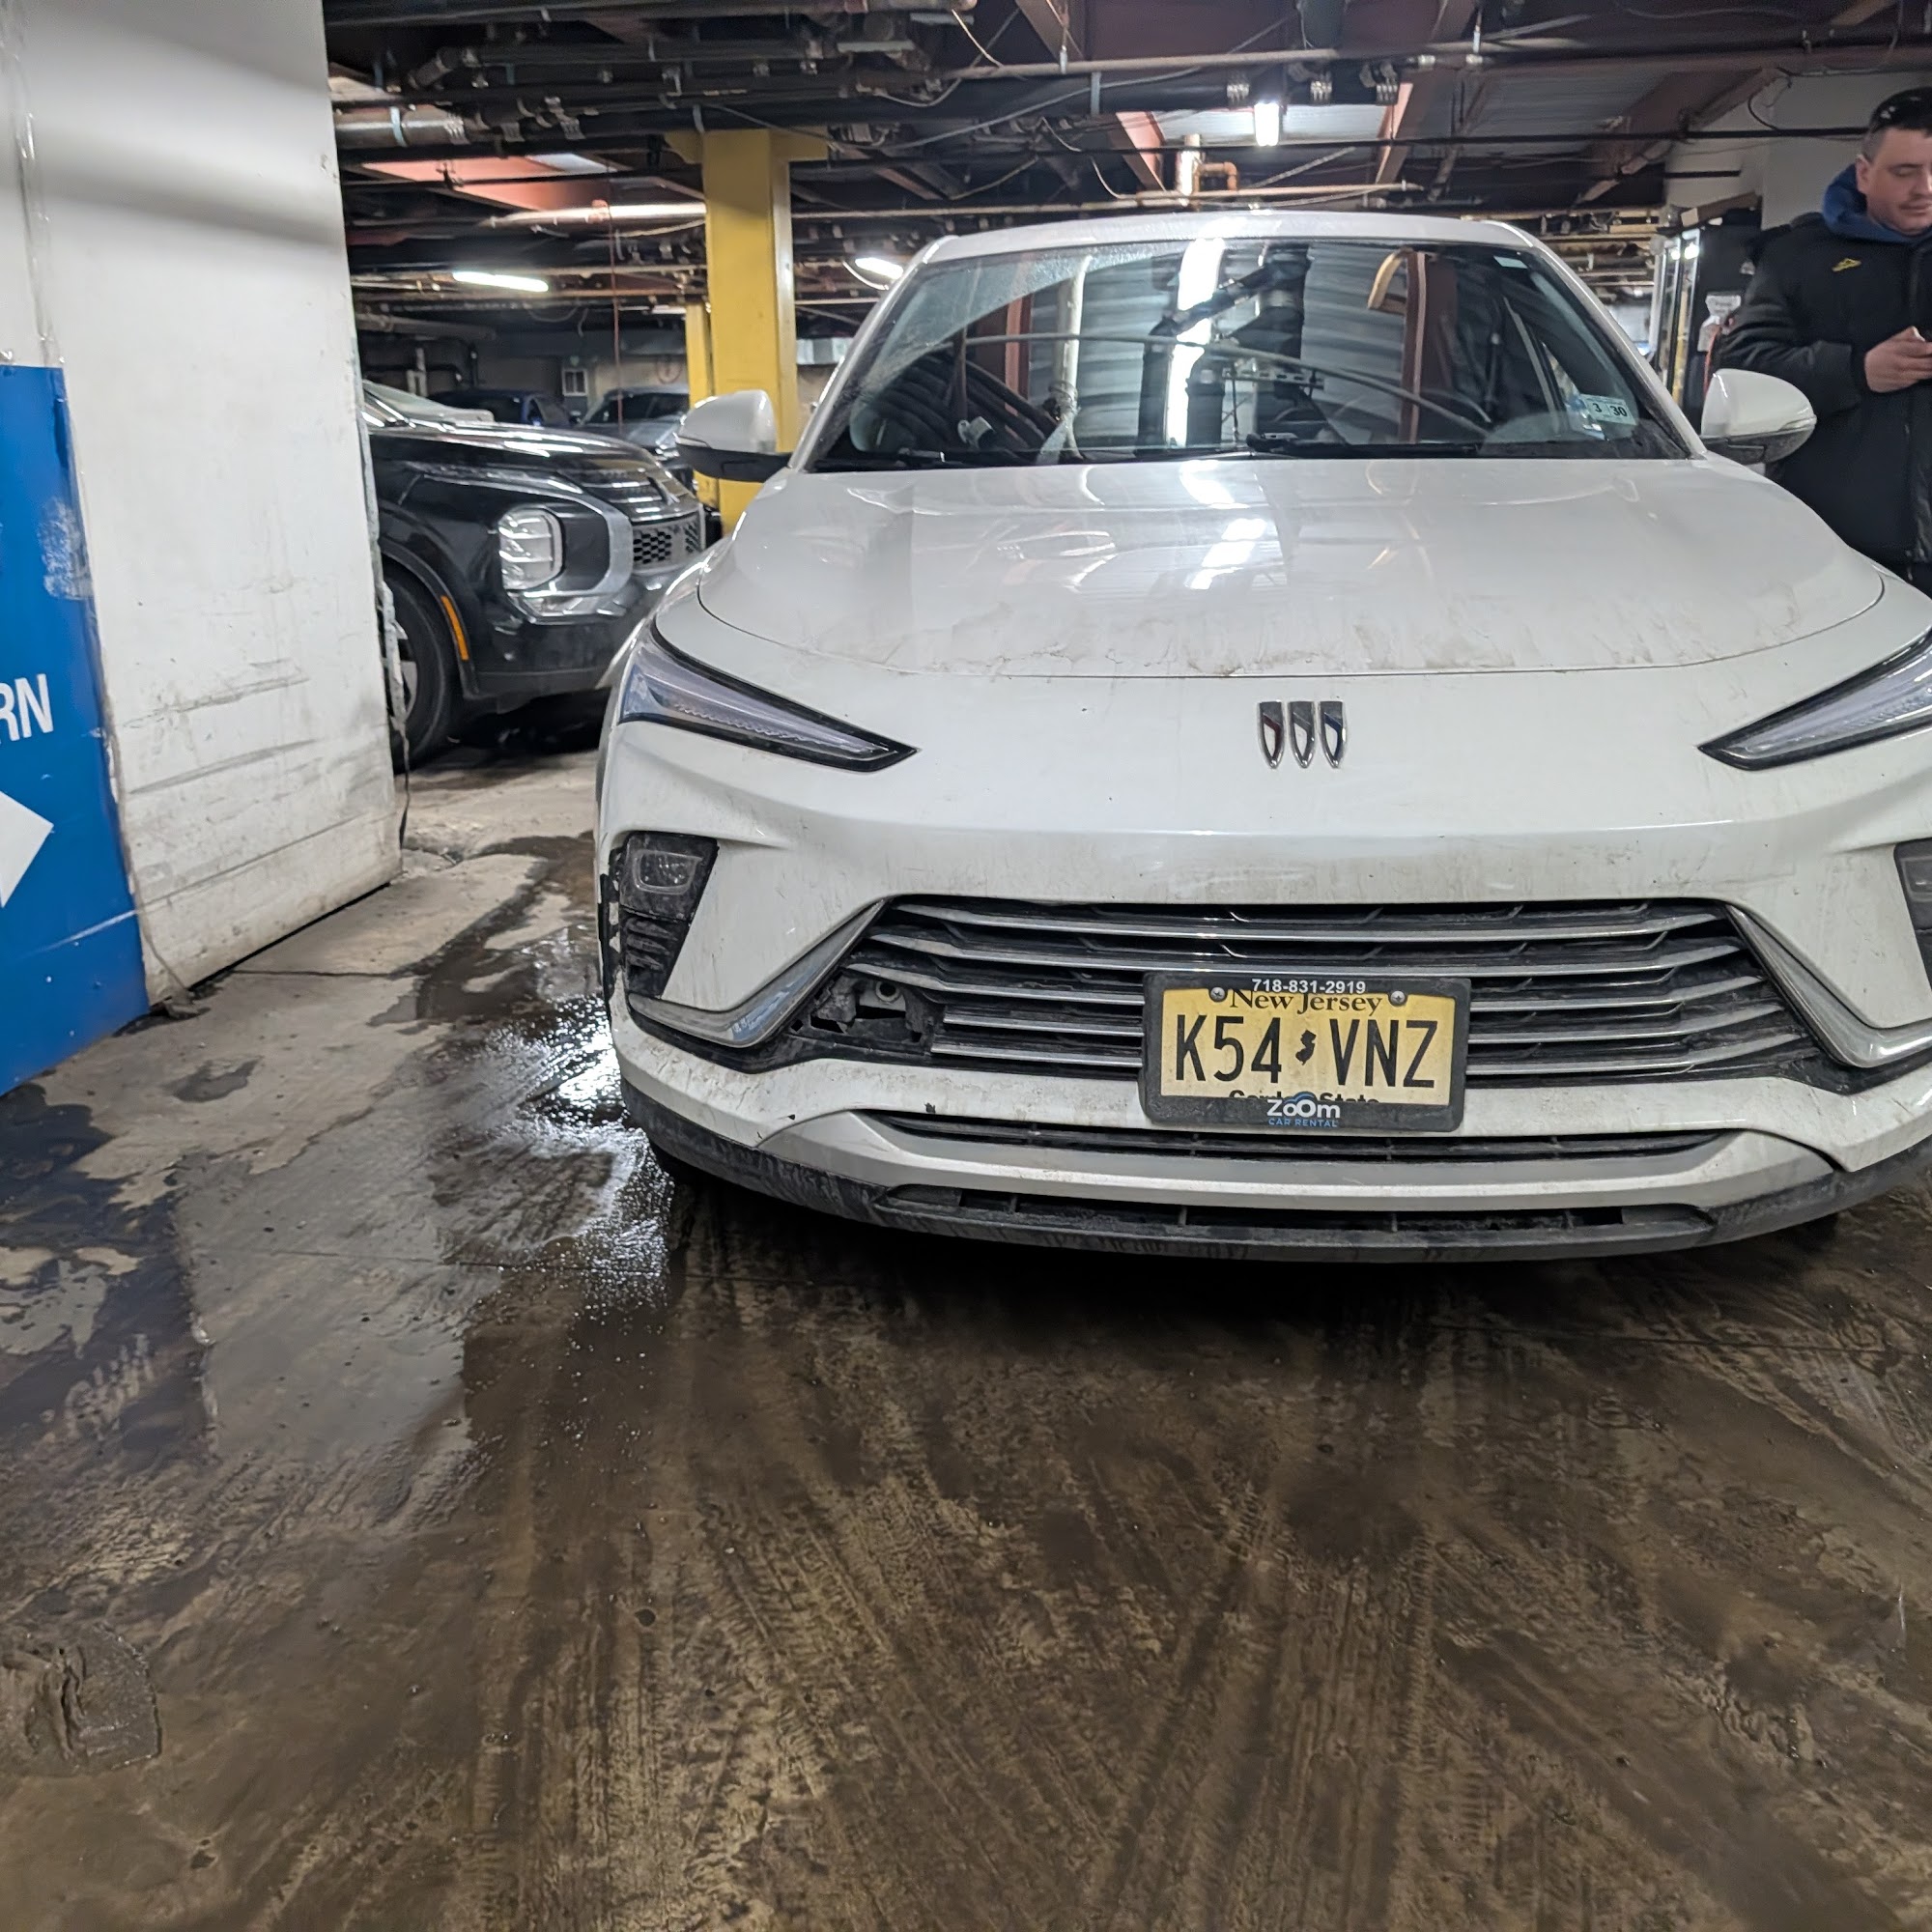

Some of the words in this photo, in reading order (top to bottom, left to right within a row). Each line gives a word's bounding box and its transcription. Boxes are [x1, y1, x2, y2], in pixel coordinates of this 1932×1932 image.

[1609, 406, 1628, 416] 30
[1252, 978, 1366, 994] 718-831-2919
[1230, 989, 1293, 1009] New
[1296, 993, 1383, 1016] Jersey
[1175, 1014, 1282, 1084] K54
[1328, 1018, 1438, 1089] VNZ
[1294, 1119, 1338, 1127] RENTAL
